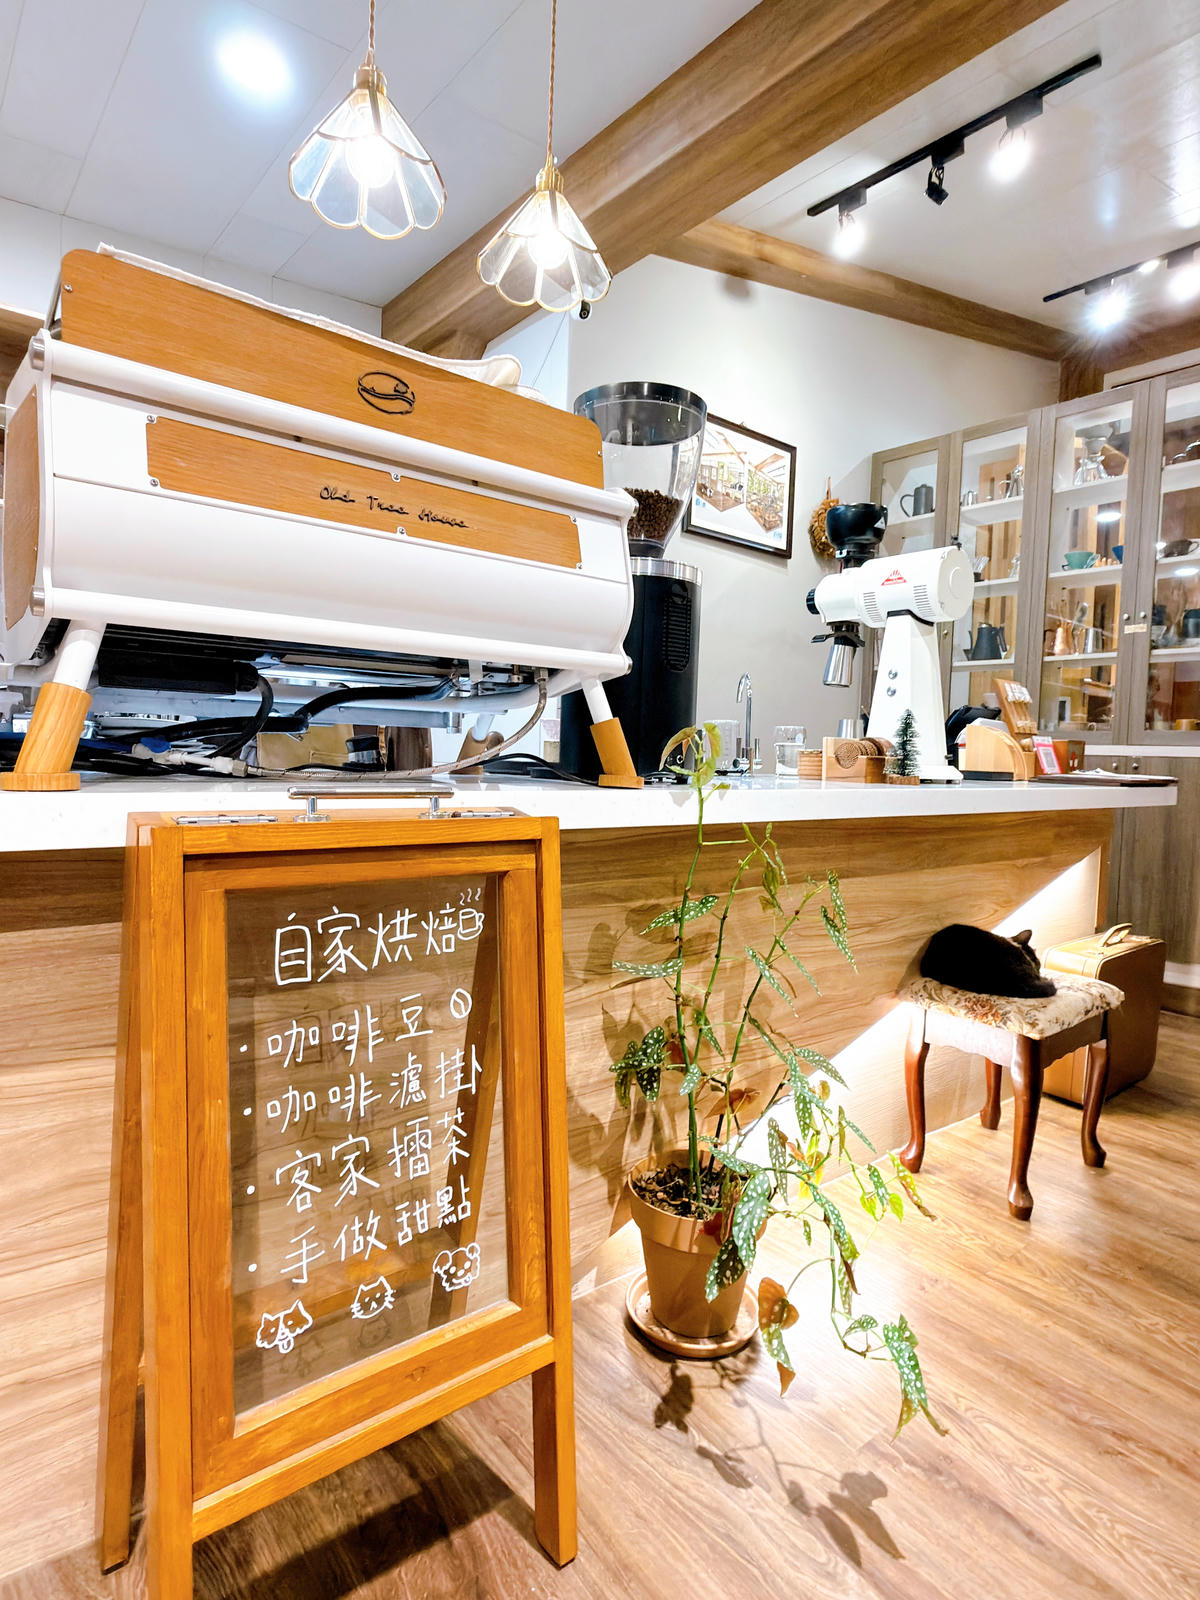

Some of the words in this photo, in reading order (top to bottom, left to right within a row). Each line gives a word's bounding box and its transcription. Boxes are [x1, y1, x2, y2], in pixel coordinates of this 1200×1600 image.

[319, 485, 356, 503] Old
[366, 495, 410, 514] Tree
[417, 507, 469, 529] House
[274, 903, 457, 985] 自家烘焙
[267, 993, 434, 1068] 咖啡豆
[266, 1044, 482, 1133] 咖啡濾掛
[275, 1108, 470, 1214] 客家擂茶
[280, 1174, 471, 1284] 手做甜點
